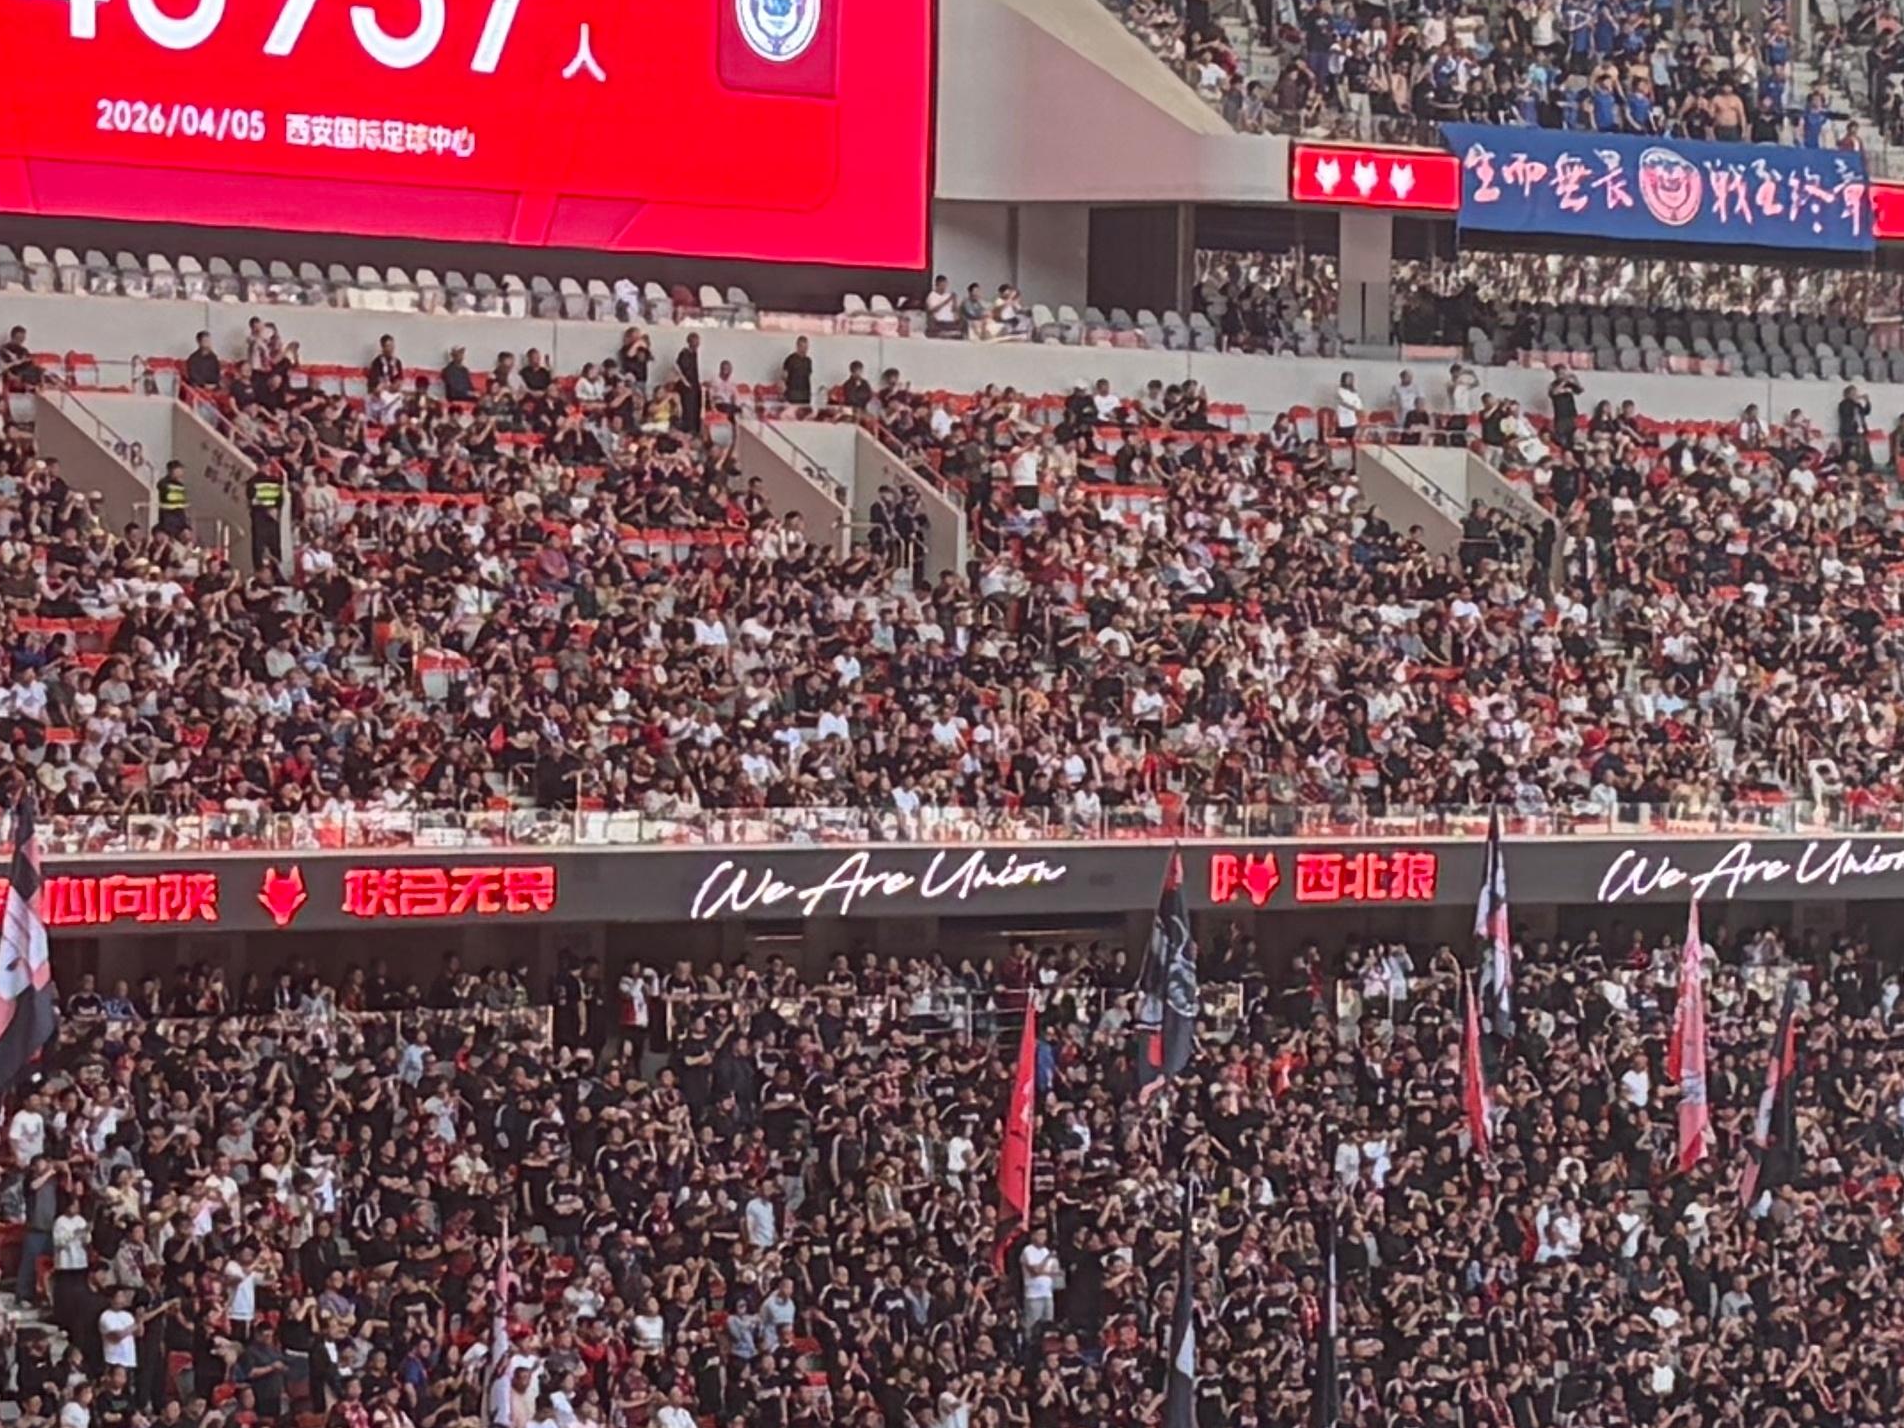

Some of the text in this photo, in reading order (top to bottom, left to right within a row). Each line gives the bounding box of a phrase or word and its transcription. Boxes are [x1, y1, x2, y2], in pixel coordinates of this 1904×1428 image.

[562, 23, 606, 82] 人
[96, 99, 477, 159] 2026/04/05 西安国际足球中心
[341, 865, 555, 917] 联合无畏
[690, 849, 1068, 920] We Are Union
[1596, 850, 1686, 902] We
[1690, 841, 1793, 900] Are
